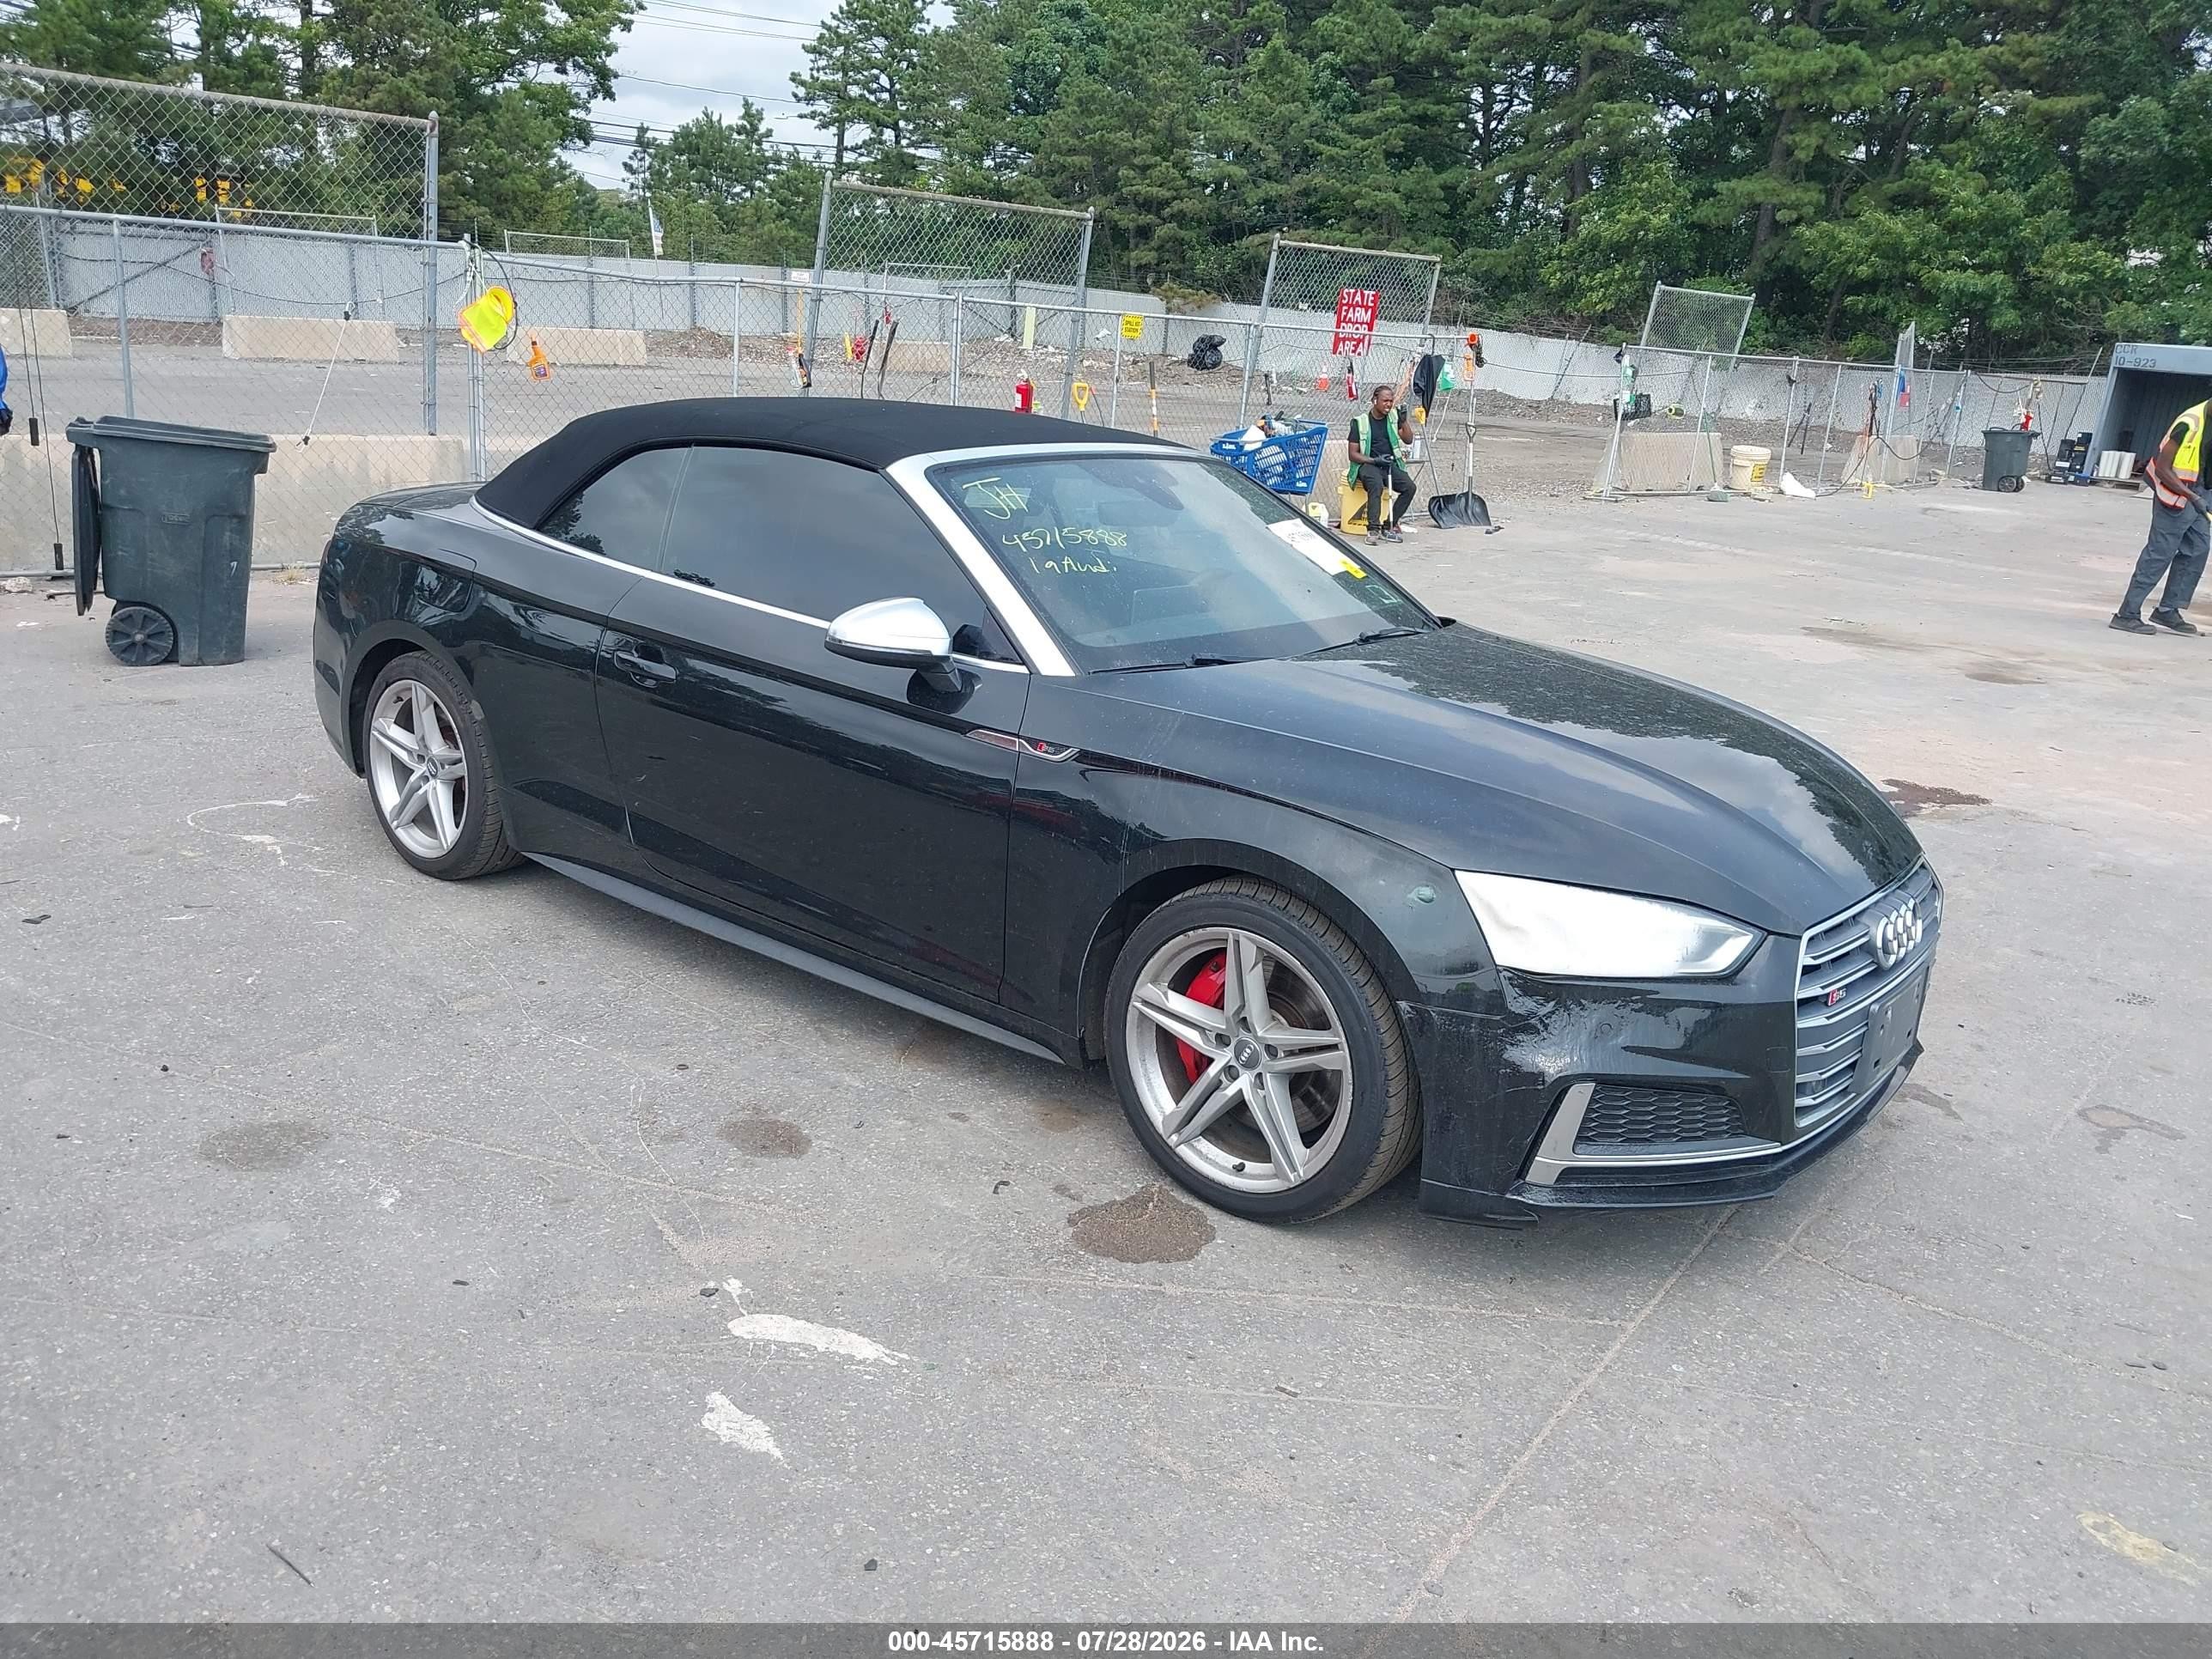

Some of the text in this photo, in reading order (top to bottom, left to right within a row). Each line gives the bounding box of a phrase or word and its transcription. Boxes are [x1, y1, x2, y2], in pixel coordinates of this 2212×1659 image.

[1341, 288, 1376, 307] STATE
[1340, 306, 1372, 324] FARM
[1339, 322, 1369, 339] DROP
[1336, 340, 1364, 356] AREA
[2115, 344, 2137, 354] CCR
[2115, 356, 2157, 368] 10-923
[1002, 526, 1127, 553] 45715888
